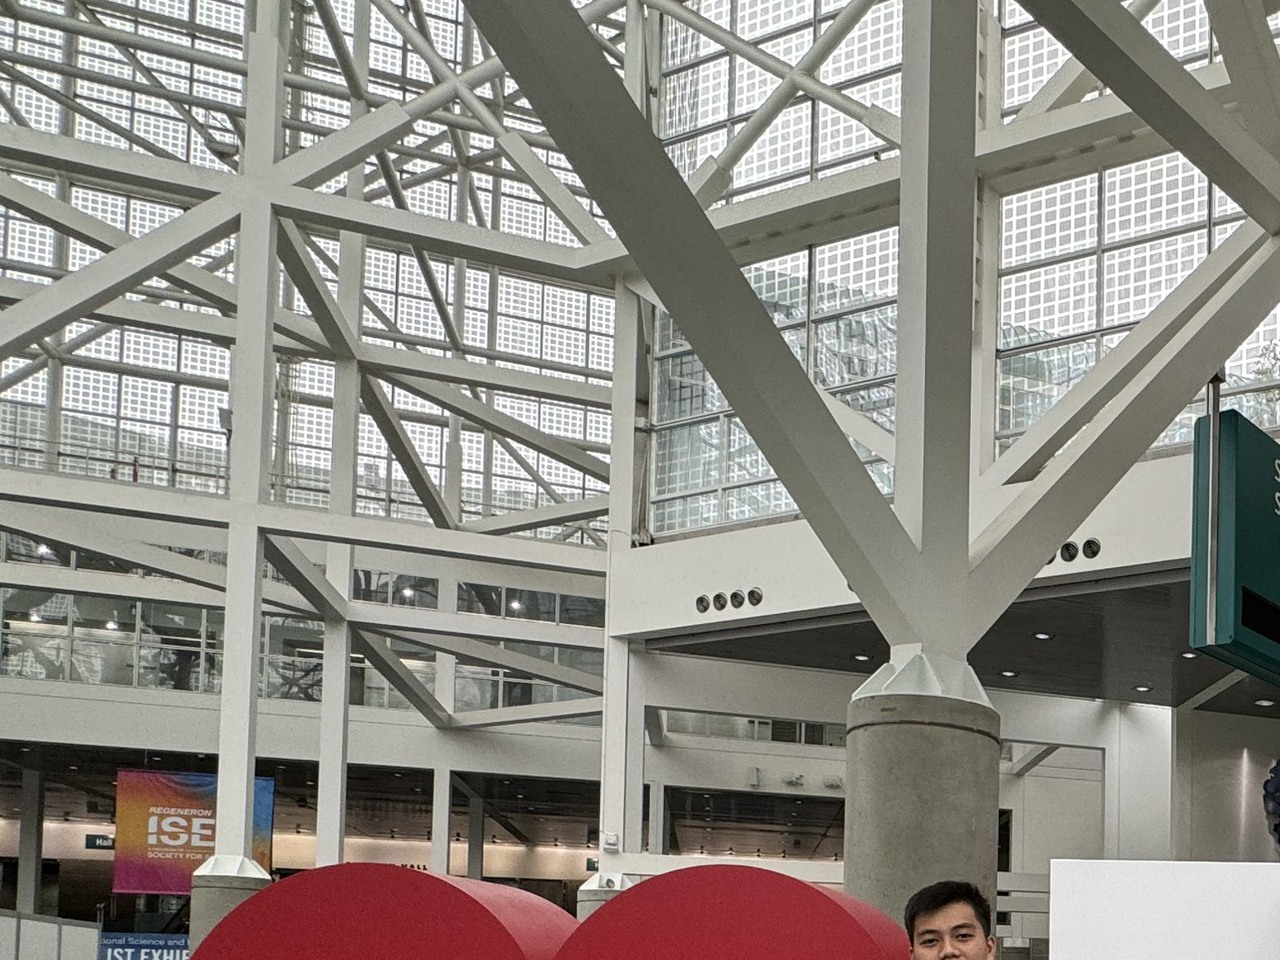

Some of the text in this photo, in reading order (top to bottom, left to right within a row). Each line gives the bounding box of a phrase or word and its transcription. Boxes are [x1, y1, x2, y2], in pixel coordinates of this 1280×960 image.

[149, 806, 213, 816] REGENERON
[148, 815, 216, 847] ISE
[95, 838, 113, 846] Hall
[147, 851, 185, 859] SOCIETY
[186, 852, 203, 860] FOR
[100, 937, 185, 946] ional Science and
